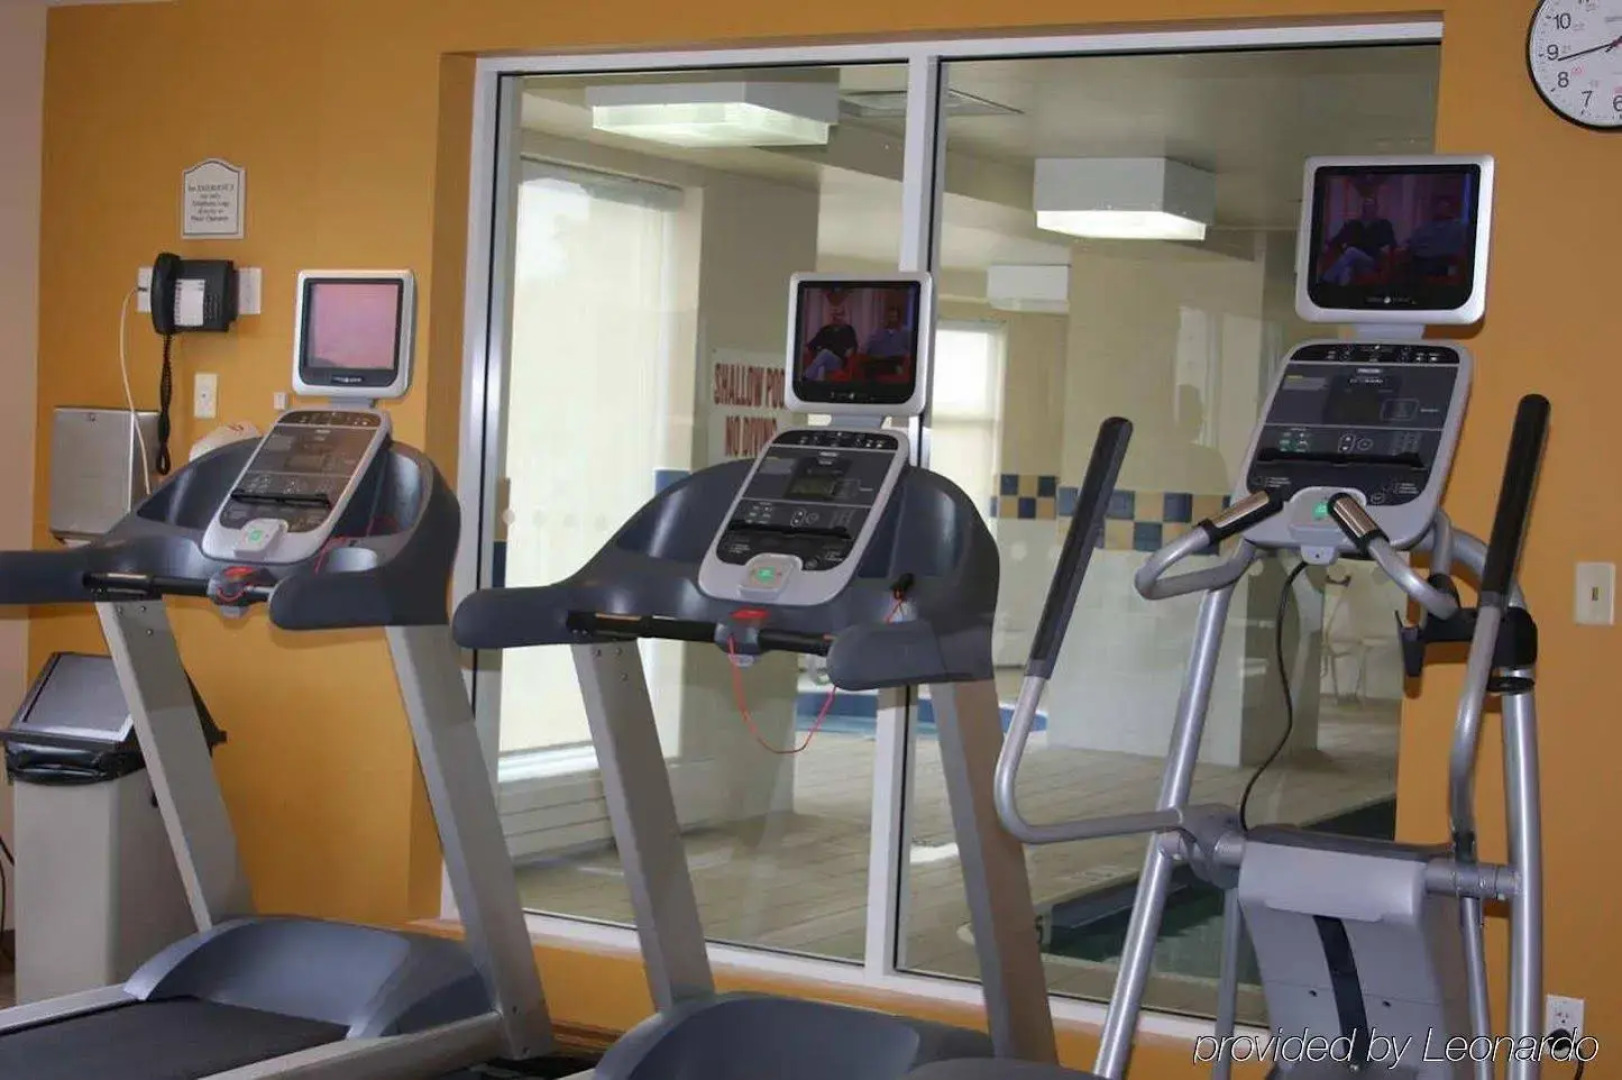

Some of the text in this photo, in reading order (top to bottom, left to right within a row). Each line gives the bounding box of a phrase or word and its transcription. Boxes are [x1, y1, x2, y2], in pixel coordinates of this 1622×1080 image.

[1553, 12, 1571, 29] 10
[1546, 44, 1559, 61] 9
[1557, 71, 1569, 88] 8
[1581, 90, 1593, 108] 7
[714, 363, 786, 409] SHALLOW POO
[725, 415, 740, 457] NO
